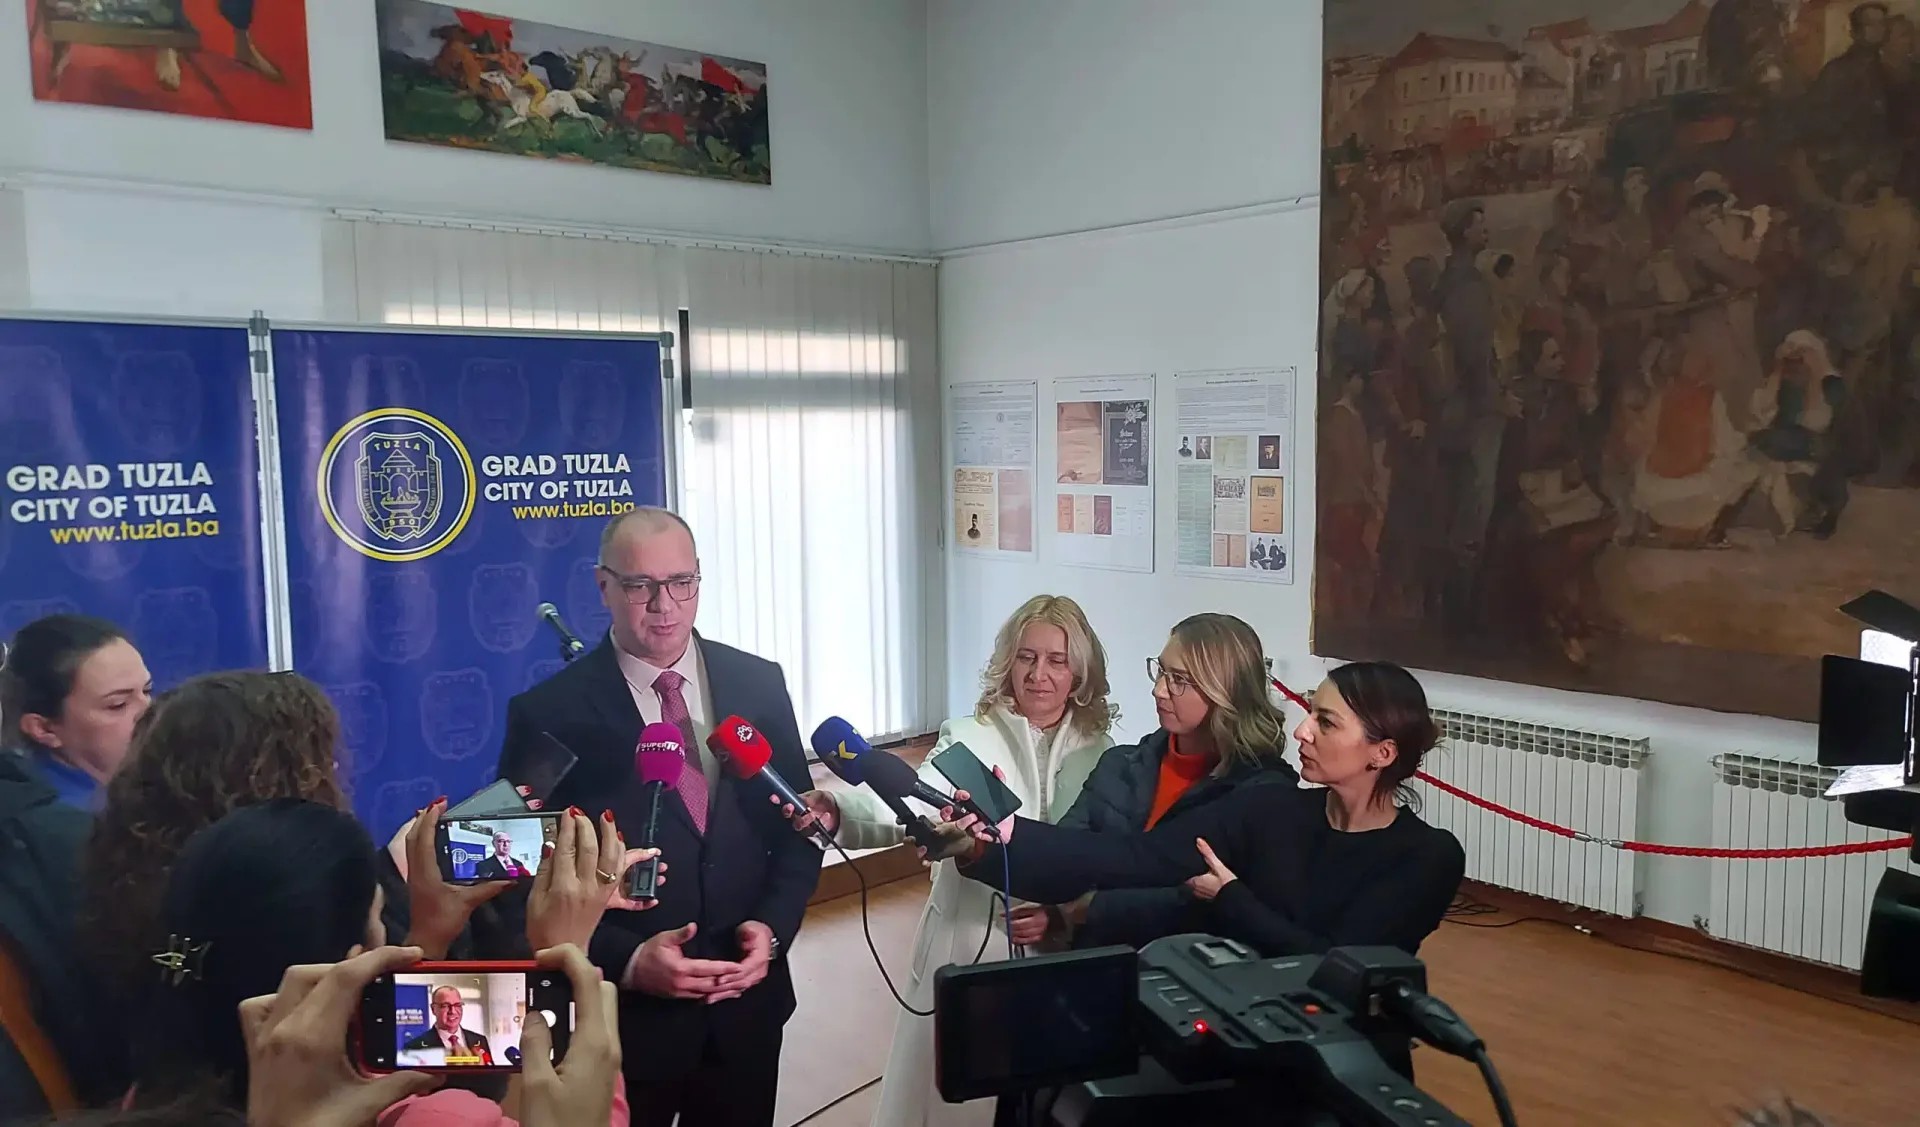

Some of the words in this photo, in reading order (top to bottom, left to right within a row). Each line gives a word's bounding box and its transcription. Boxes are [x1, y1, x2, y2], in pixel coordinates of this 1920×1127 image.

[374, 440, 420, 451] TUZLA
[6, 464, 111, 492] GRAD
[118, 462, 213, 488] TUZLA
[481, 455, 556, 477] GRAD
[562, 453, 631, 474] TUZLA
[484, 482, 534, 501] CITY
[540, 481, 569, 499] OF
[573, 479, 633, 498] TUZLA
[10, 498, 81, 523] CITY
[88, 496, 128, 519] OF
[134, 493, 217, 517] TUZLA
[512, 500, 635, 519] www.tuzla.ba
[50, 518, 220, 544] www.tuzla.ba
